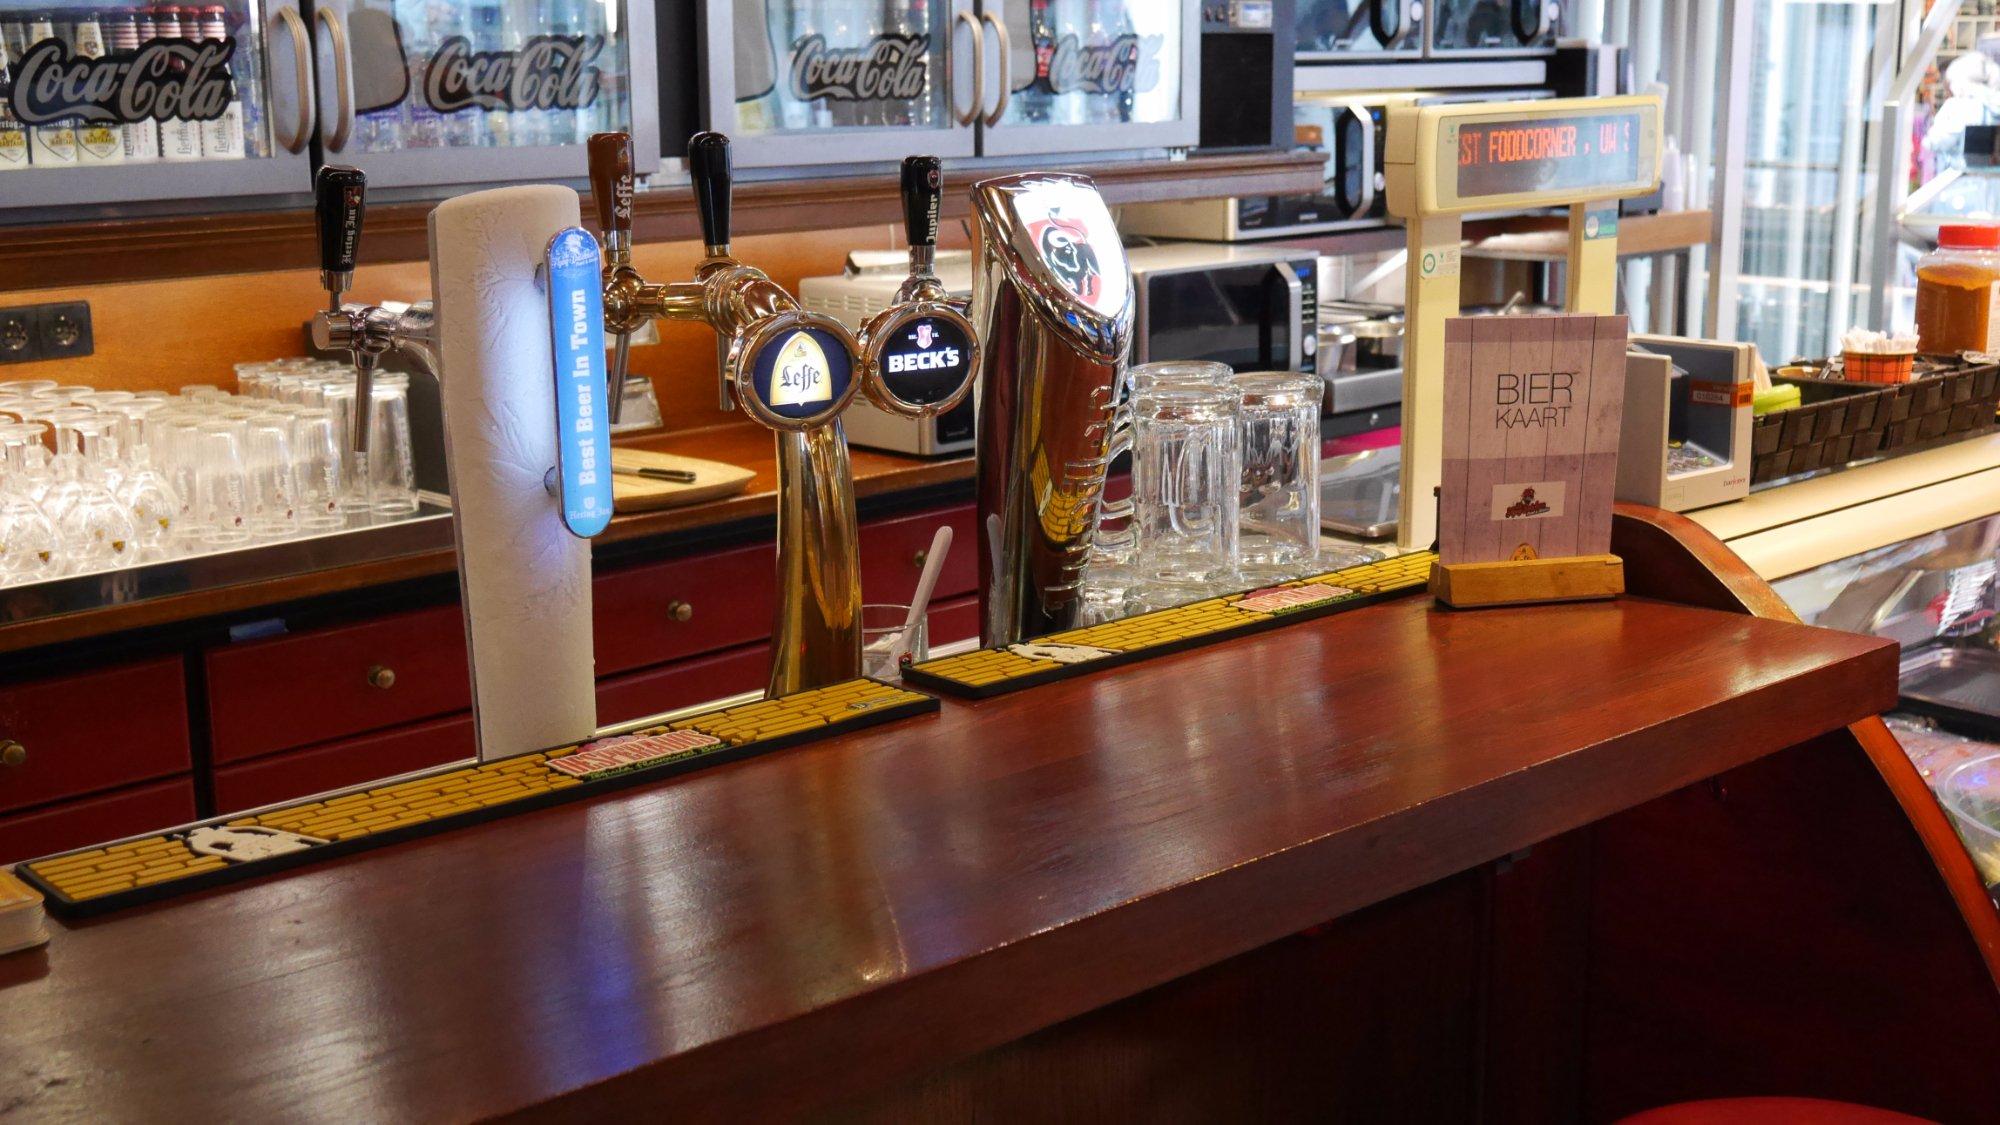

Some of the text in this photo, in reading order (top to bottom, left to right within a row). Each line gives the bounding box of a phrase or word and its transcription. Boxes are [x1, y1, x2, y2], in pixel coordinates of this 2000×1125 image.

[12, 37, 236, 123] Coca-Cola
[427, 36, 603, 110] Coca-Cola
[791, 35, 929, 100] Coca-Cola
[1488, 126, 1577, 163] FOODCORNER
[615, 174, 631, 218] Leffe
[926, 194, 938, 243] Jupiler
[342, 208, 357, 264] Hertog Jan
[780, 362, 823, 393] Leffe
[888, 346, 960, 374] BECK'S
[570, 289, 597, 486] Best Beer In Town
[1496, 371, 1575, 406] BIER
[1495, 406, 1572, 430] KAART
